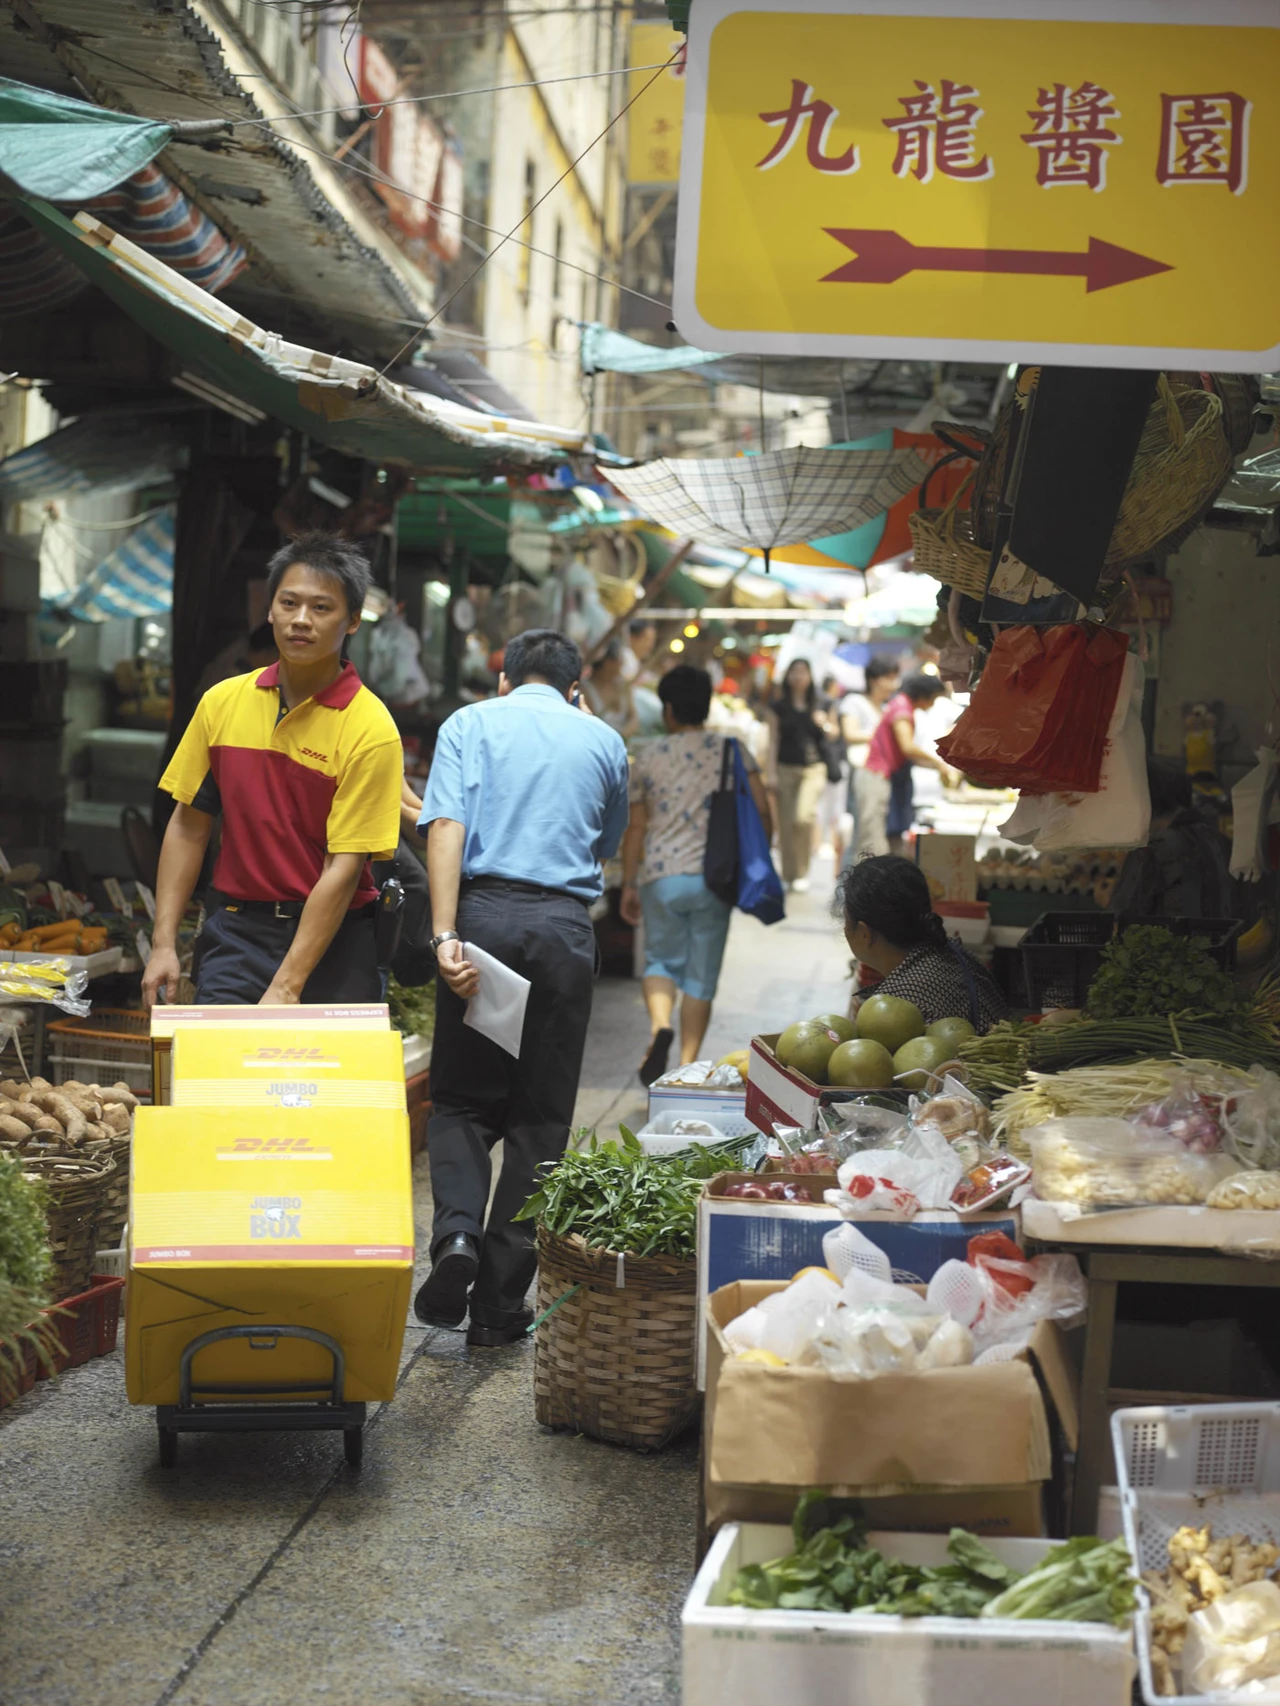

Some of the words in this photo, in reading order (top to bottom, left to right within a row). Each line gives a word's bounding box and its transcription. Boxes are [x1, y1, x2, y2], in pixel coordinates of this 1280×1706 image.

[755, 79, 1253, 196] 九龍醬園
[299, 746, 328, 763] DHL
[257, 1047, 325, 1060] DHL
[265, 1083, 318, 1096] JUMBO
[233, 1138, 315, 1152] DHL
[250, 1196, 302, 1210] JUMBO
[250, 1214, 303, 1239] BOX
[149, 1250, 175, 1259] JUMBO
[175, 1249, 192, 1258] BOX
